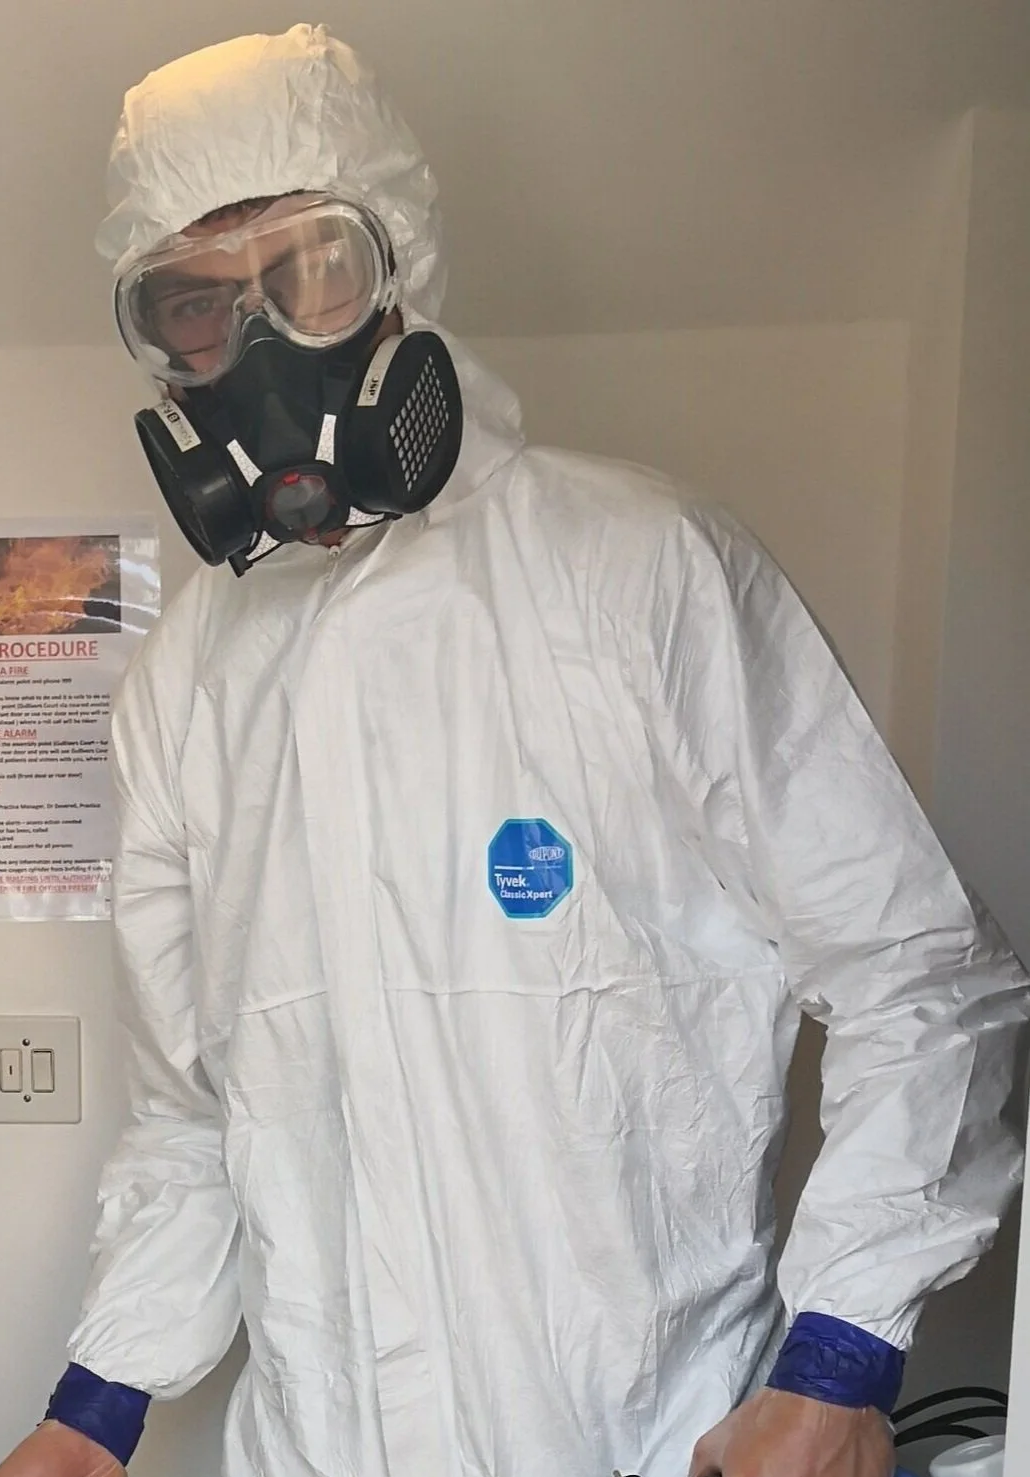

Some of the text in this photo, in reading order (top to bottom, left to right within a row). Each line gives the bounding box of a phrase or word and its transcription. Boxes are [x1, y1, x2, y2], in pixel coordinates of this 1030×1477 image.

[0, 667, 7, 676] A
[9, 666, 29, 675] FIRE
[3, 728, 37, 738] ALARM
[532, 847, 562, 861] DUPONT
[494, 873, 526, 889] Tyvek
